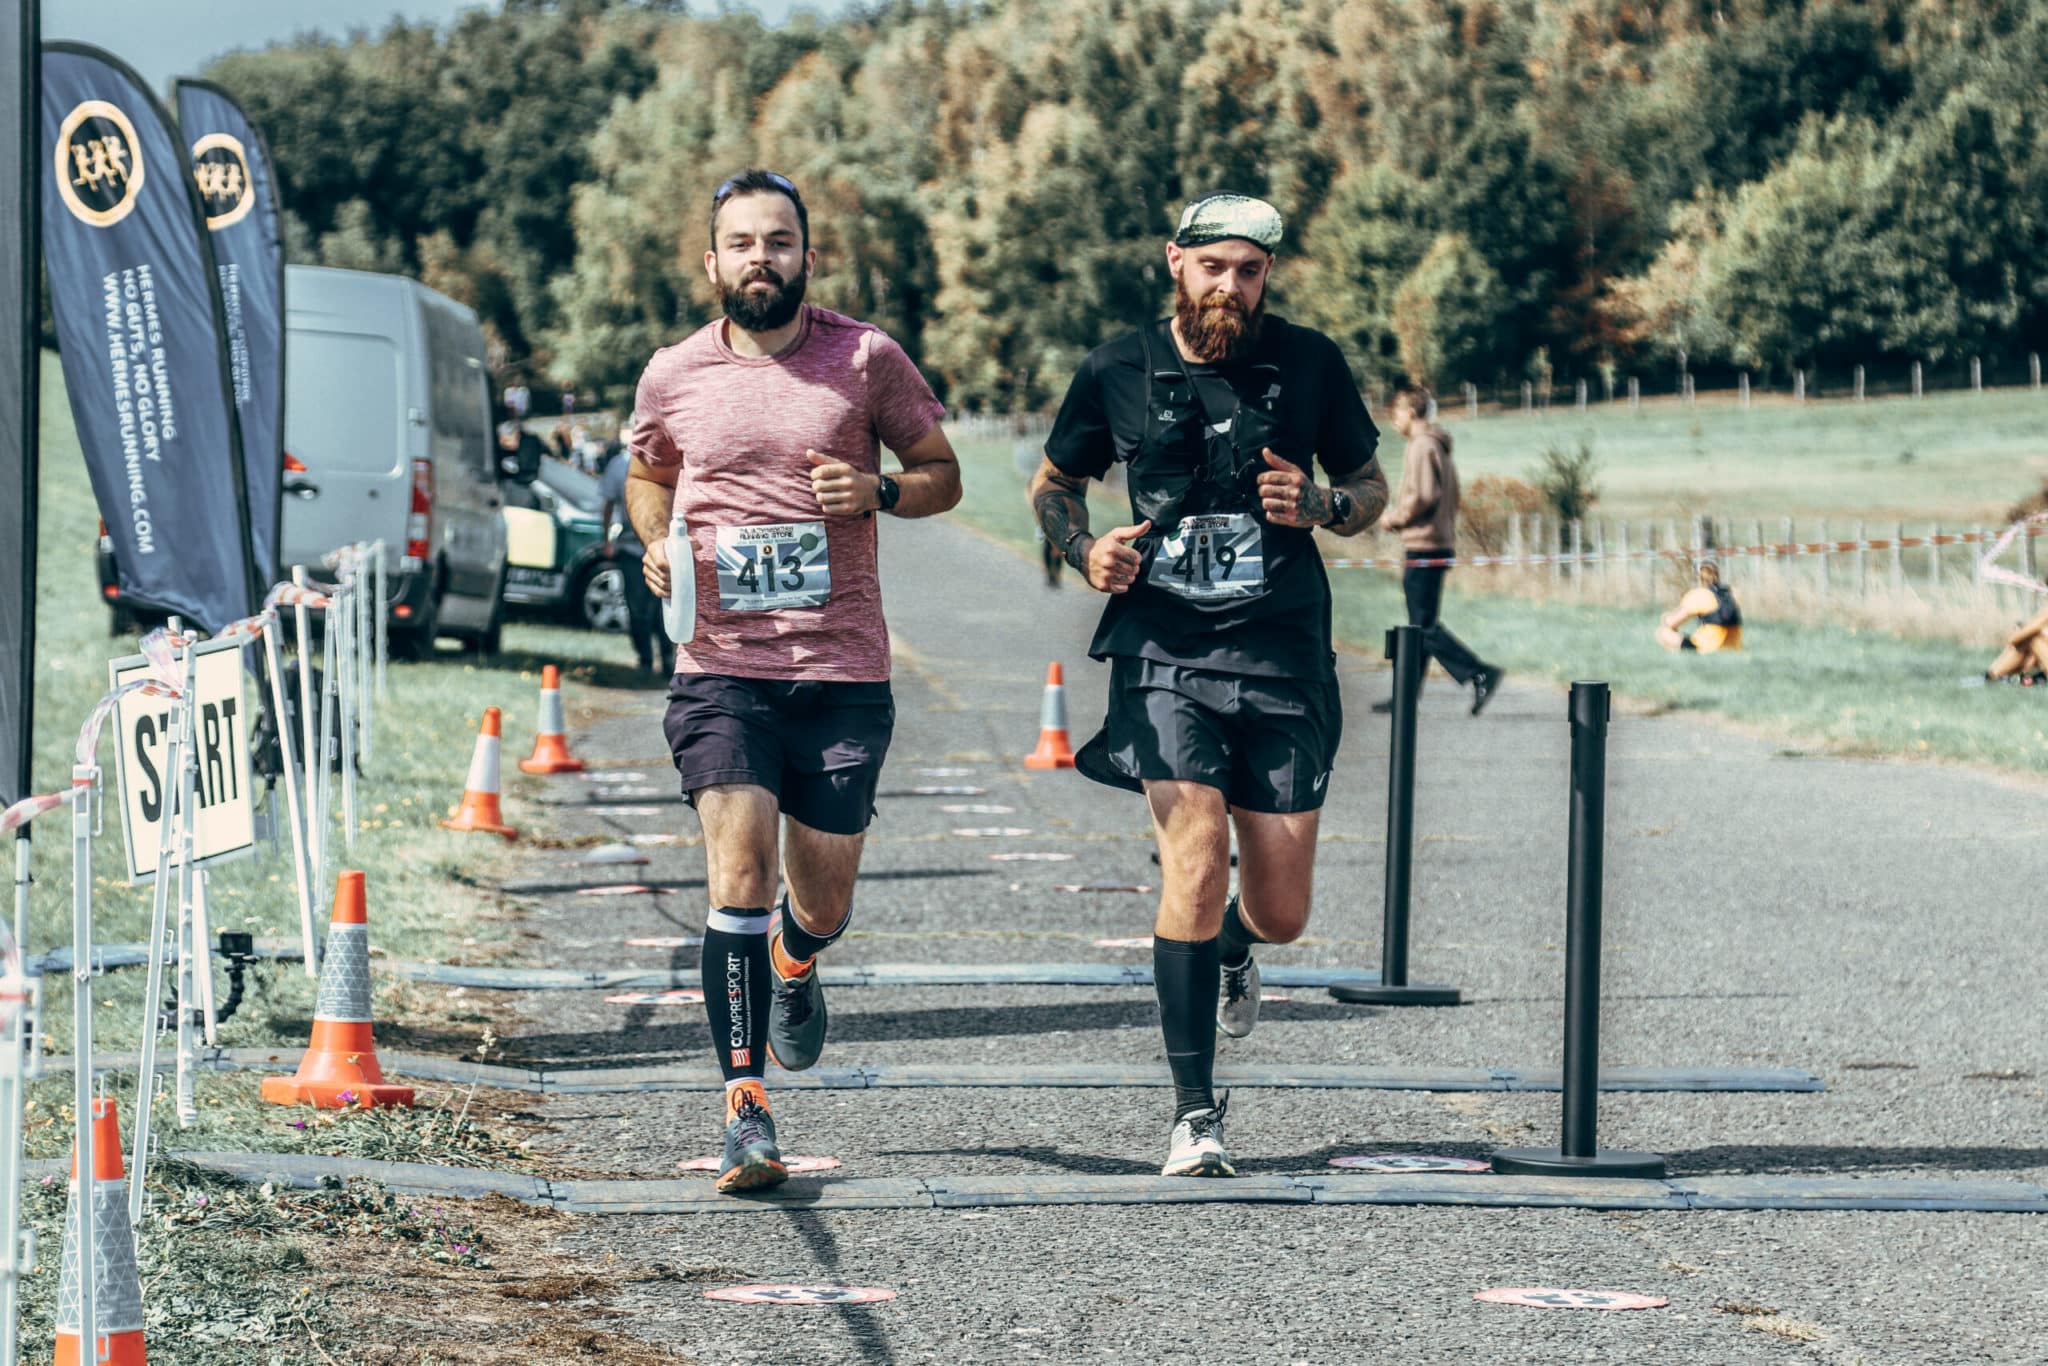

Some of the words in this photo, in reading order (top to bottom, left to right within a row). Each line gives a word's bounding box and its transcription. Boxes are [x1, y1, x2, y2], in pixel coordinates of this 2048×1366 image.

[122, 268, 139, 300] NO
[125, 301, 146, 362] GUTS,
[136, 264, 163, 345] HERMES
[151, 347, 177, 441] RUNNING
[133, 363, 152, 395] NO
[103, 272, 154, 554] WWW.HERMESRUNNING.COM
[137, 396, 161, 462] GLORY
[737, 556, 805, 593] 413
[1172, 546, 1236, 582] 419
